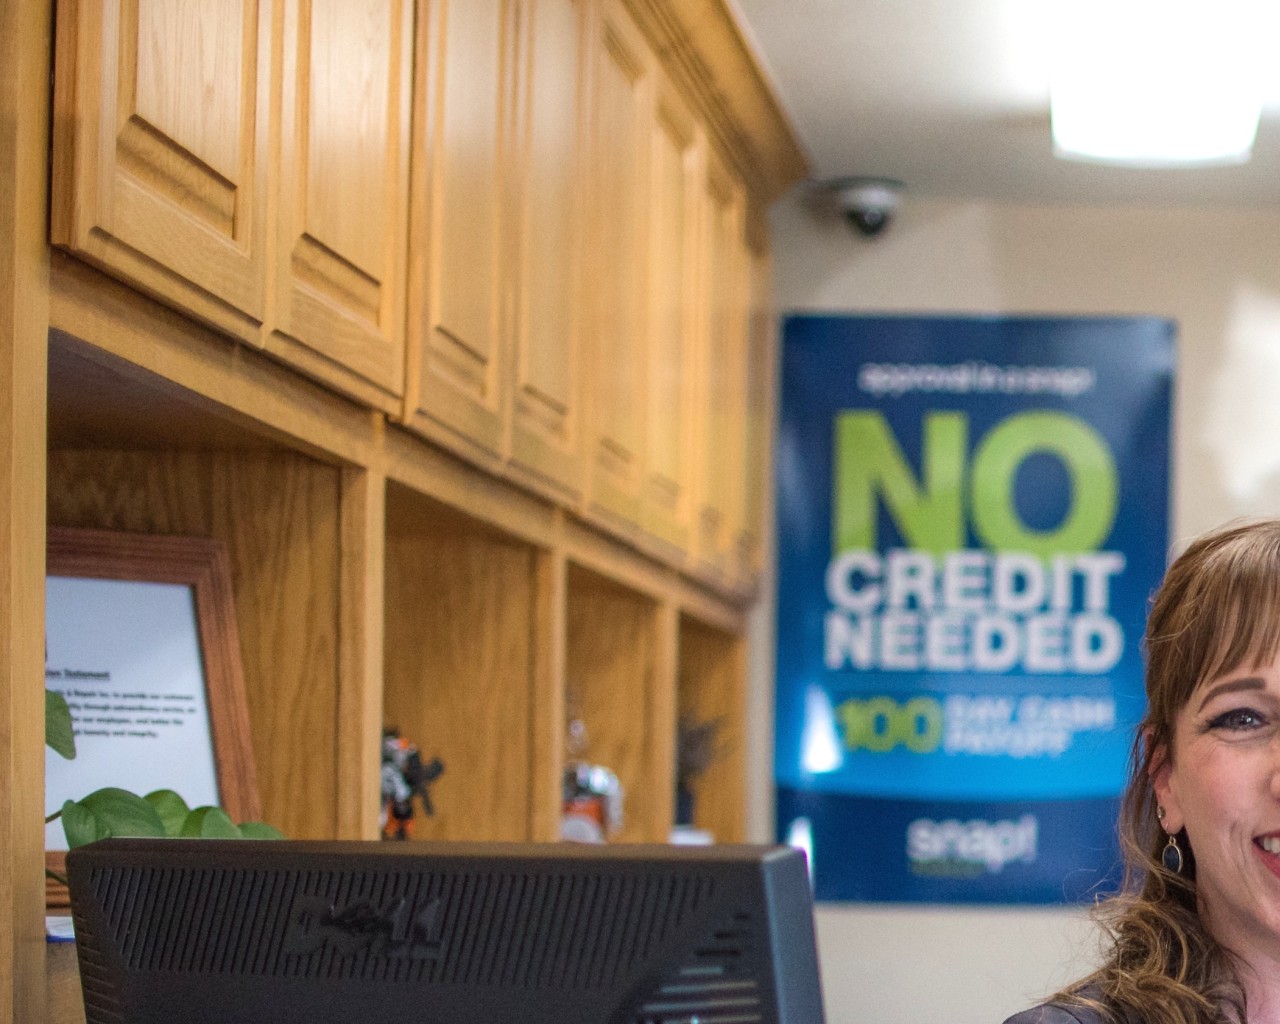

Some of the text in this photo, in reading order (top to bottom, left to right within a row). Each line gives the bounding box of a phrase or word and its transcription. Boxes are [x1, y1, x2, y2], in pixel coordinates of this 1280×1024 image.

[834, 408, 1119, 562] NO
[824, 550, 1125, 612] CREDIT
[824, 612, 1124, 673] NEEDED
[835, 697, 943, 752] 100
